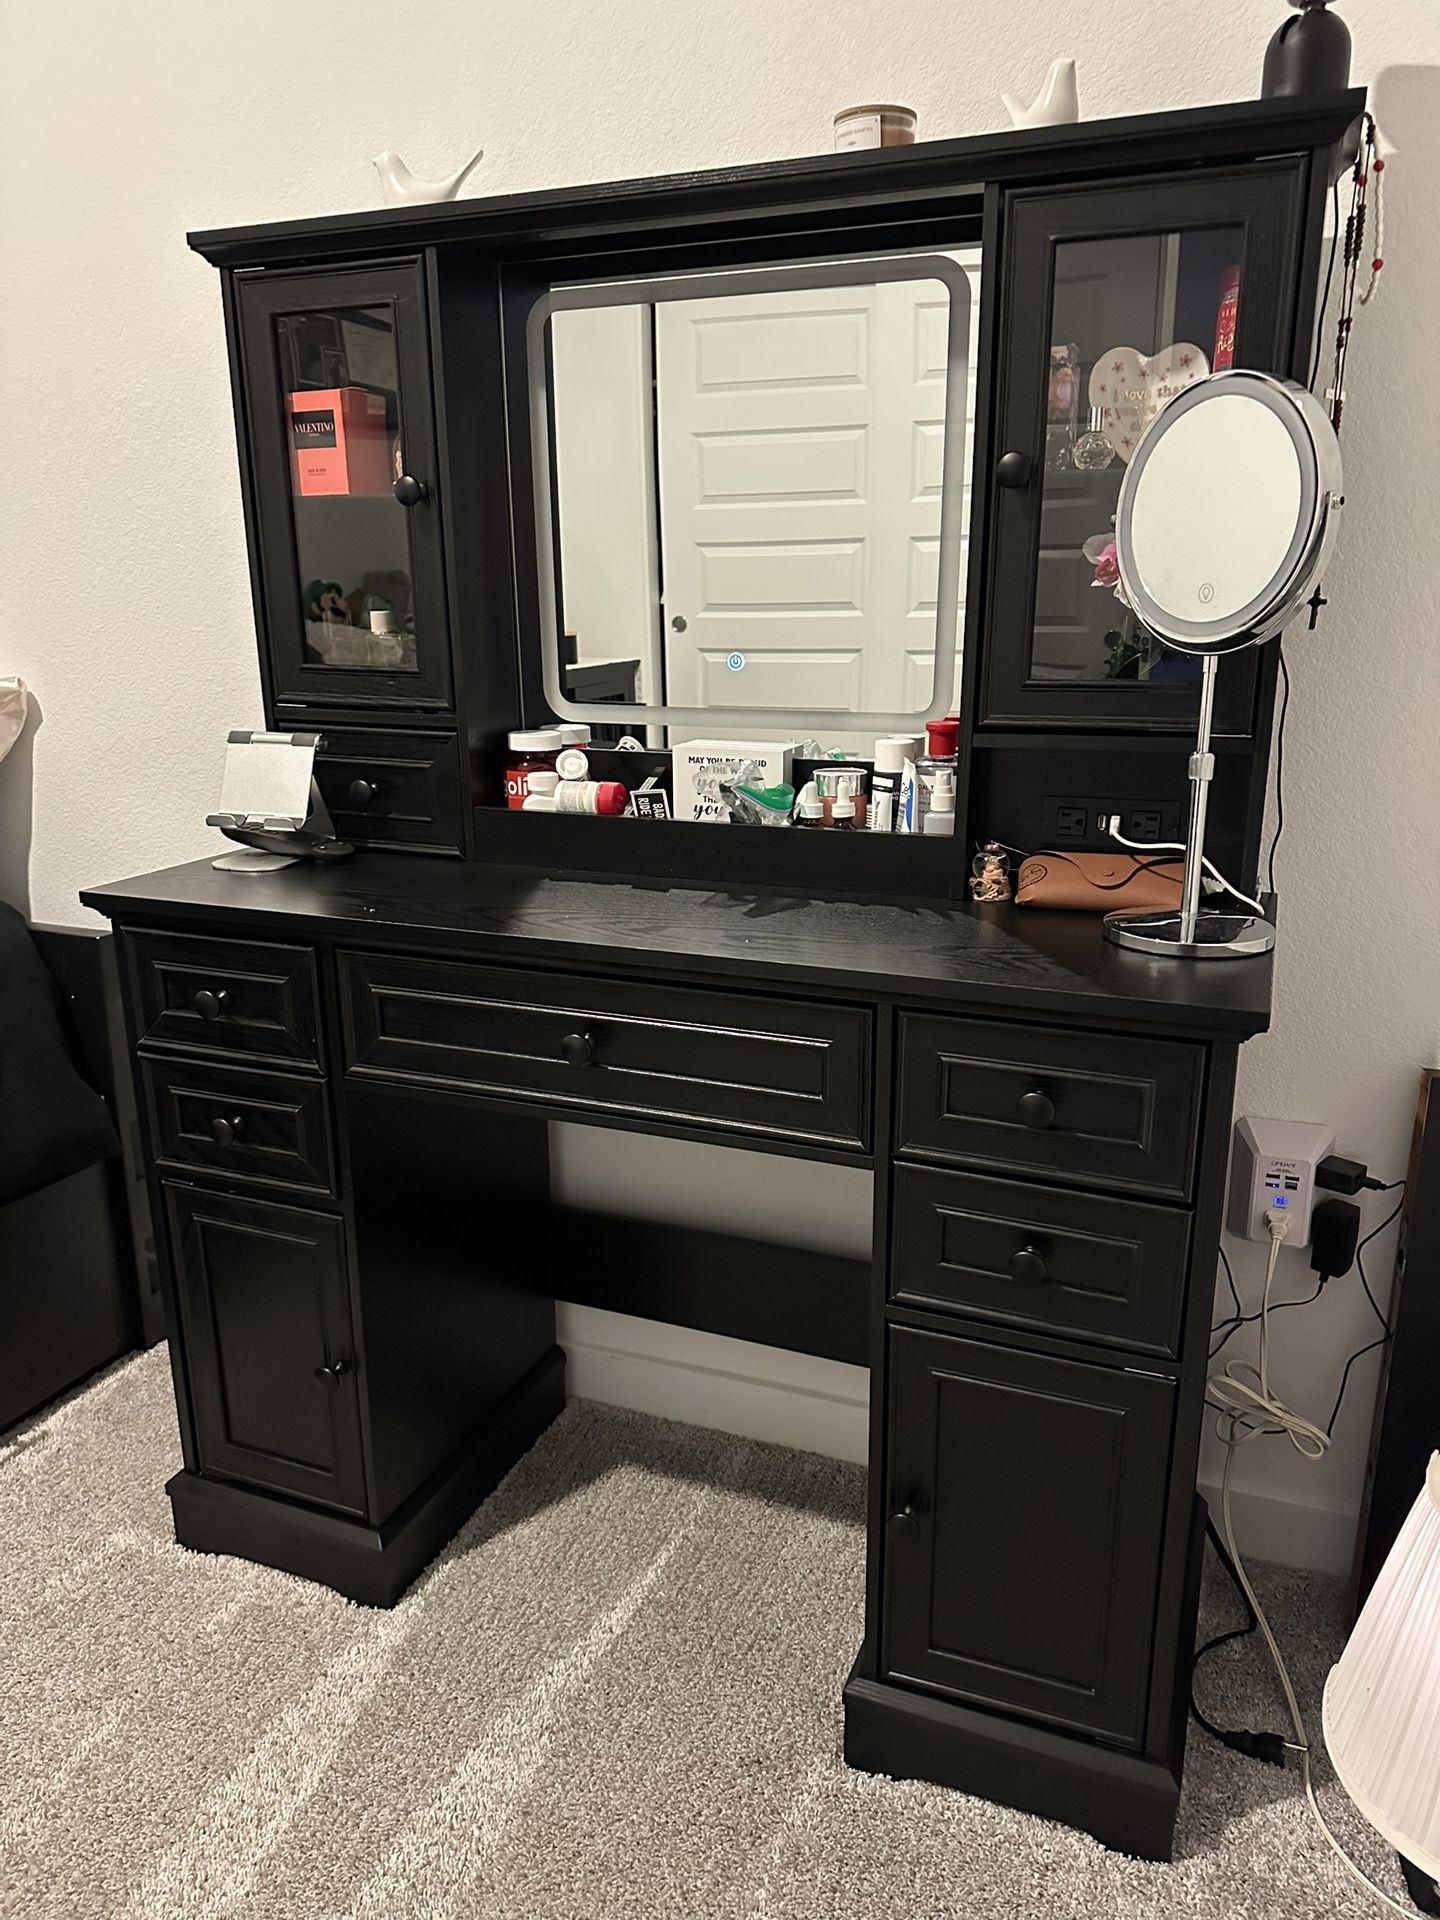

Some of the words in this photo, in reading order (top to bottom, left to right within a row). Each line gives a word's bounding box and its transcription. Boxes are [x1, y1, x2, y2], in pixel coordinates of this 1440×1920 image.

[294, 421, 334, 434] VALENTINO
[688, 756, 705, 765] MAY
[706, 757, 723, 765] YOU
[712, 766, 728, 775] THE
[637, 797, 653, 816] RIDE
[652, 802, 666, 818] BAD
